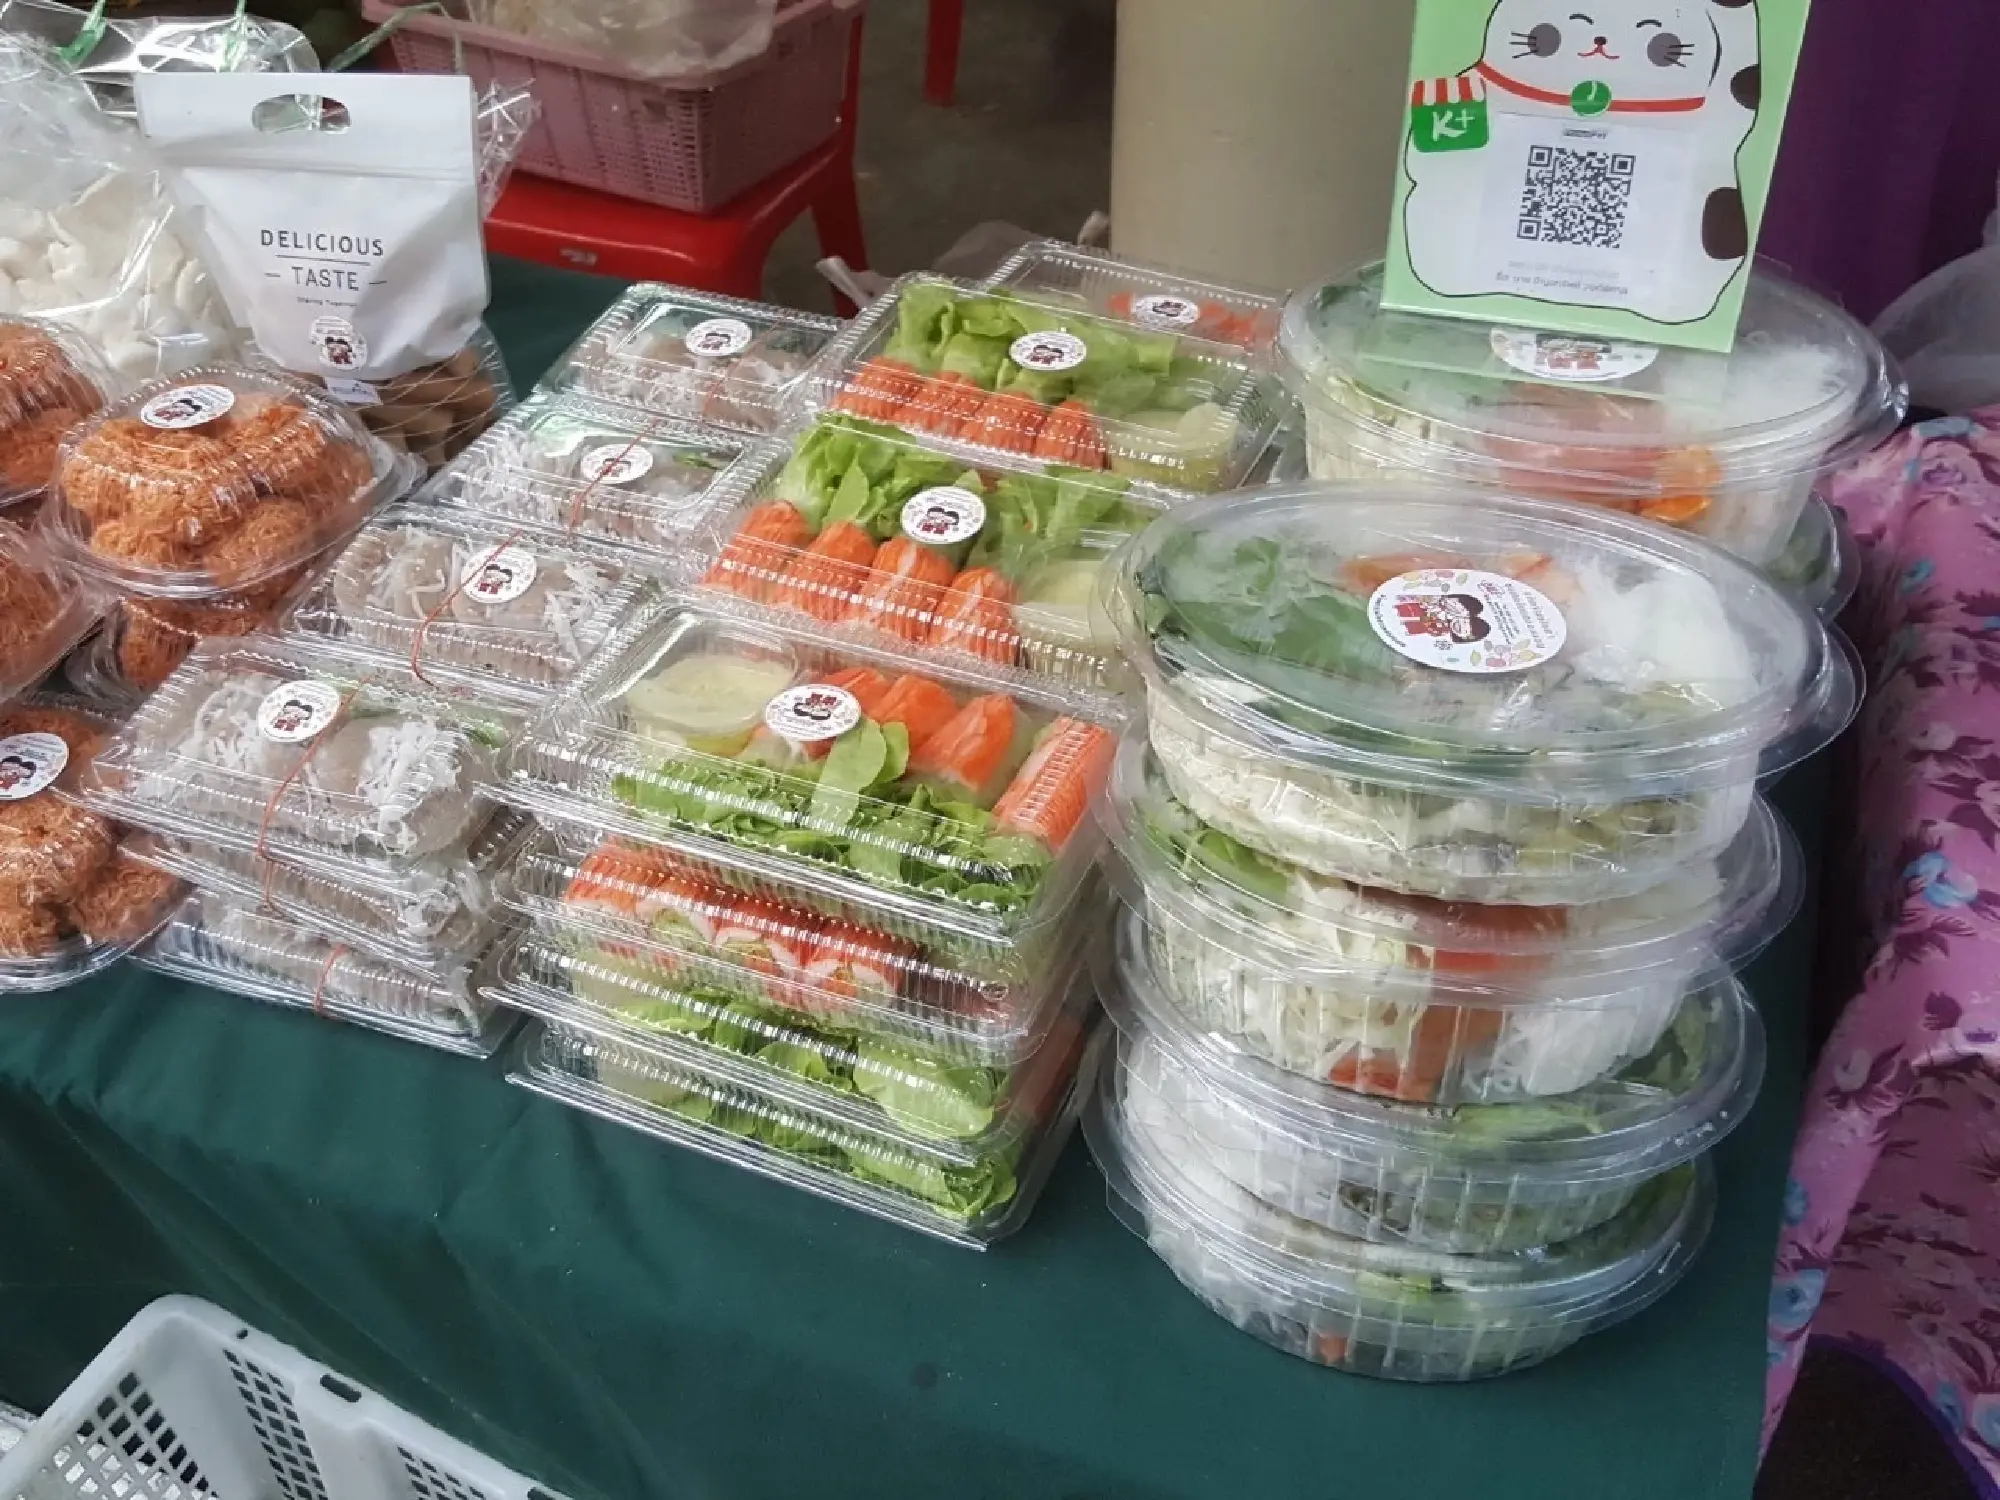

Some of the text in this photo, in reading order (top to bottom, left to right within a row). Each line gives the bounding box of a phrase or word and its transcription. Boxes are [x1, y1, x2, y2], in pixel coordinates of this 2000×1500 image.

[1432, 108, 1475, 141] K+
[261, 229, 384, 256] DELICIOUS
[291, 266, 359, 291] TASTE
